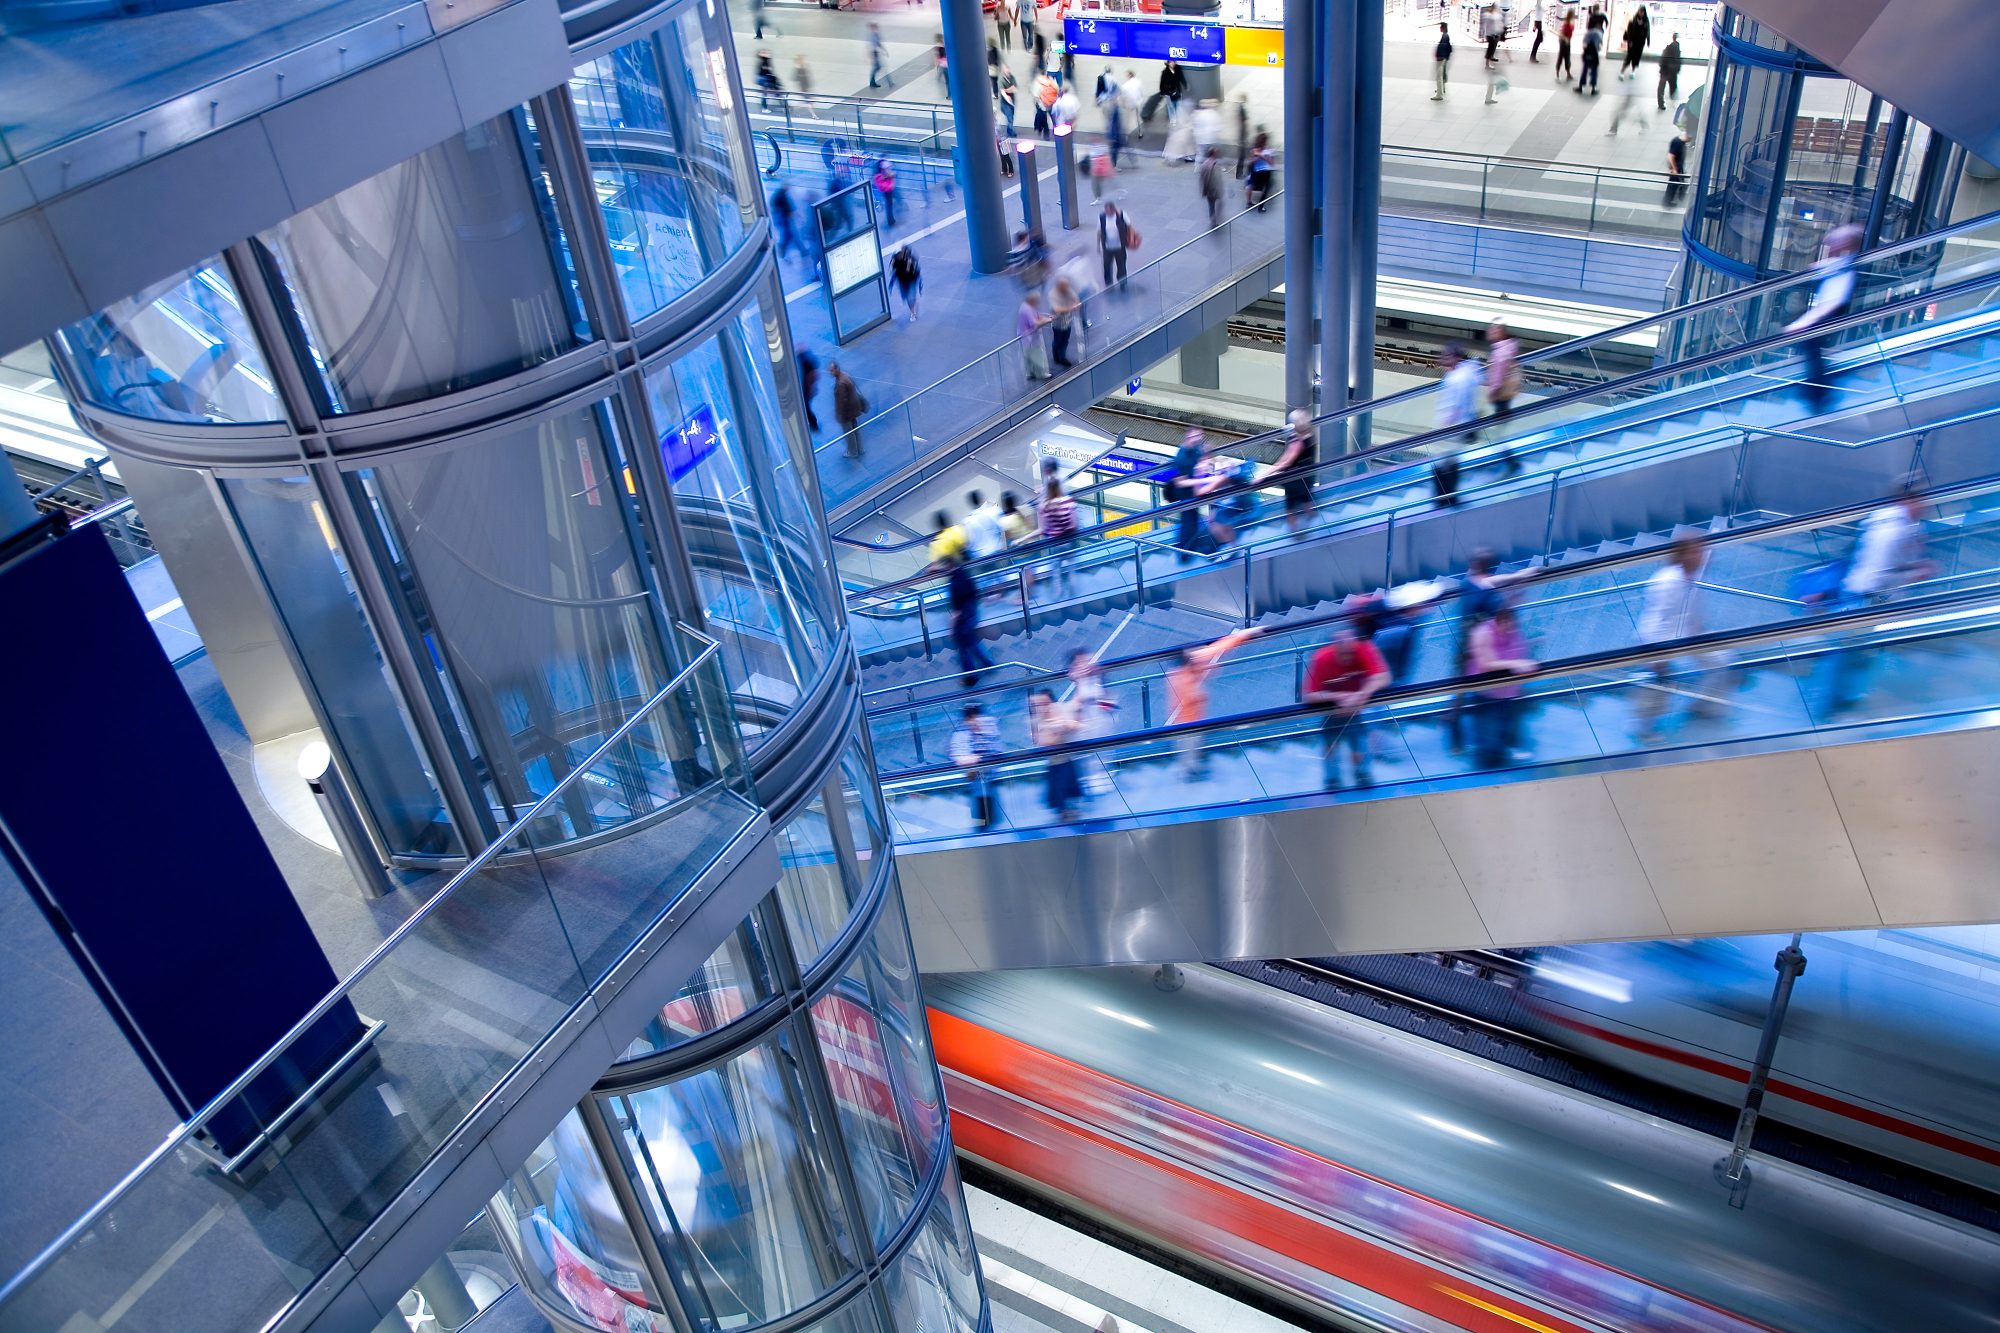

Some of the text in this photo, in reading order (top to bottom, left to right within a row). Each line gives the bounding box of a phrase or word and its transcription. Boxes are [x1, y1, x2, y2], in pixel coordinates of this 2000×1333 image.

[1078, 20, 1096, 33] 1-2
[1190, 26, 1208, 39] 1-4
[1042, 444, 1069, 458] Berlin
